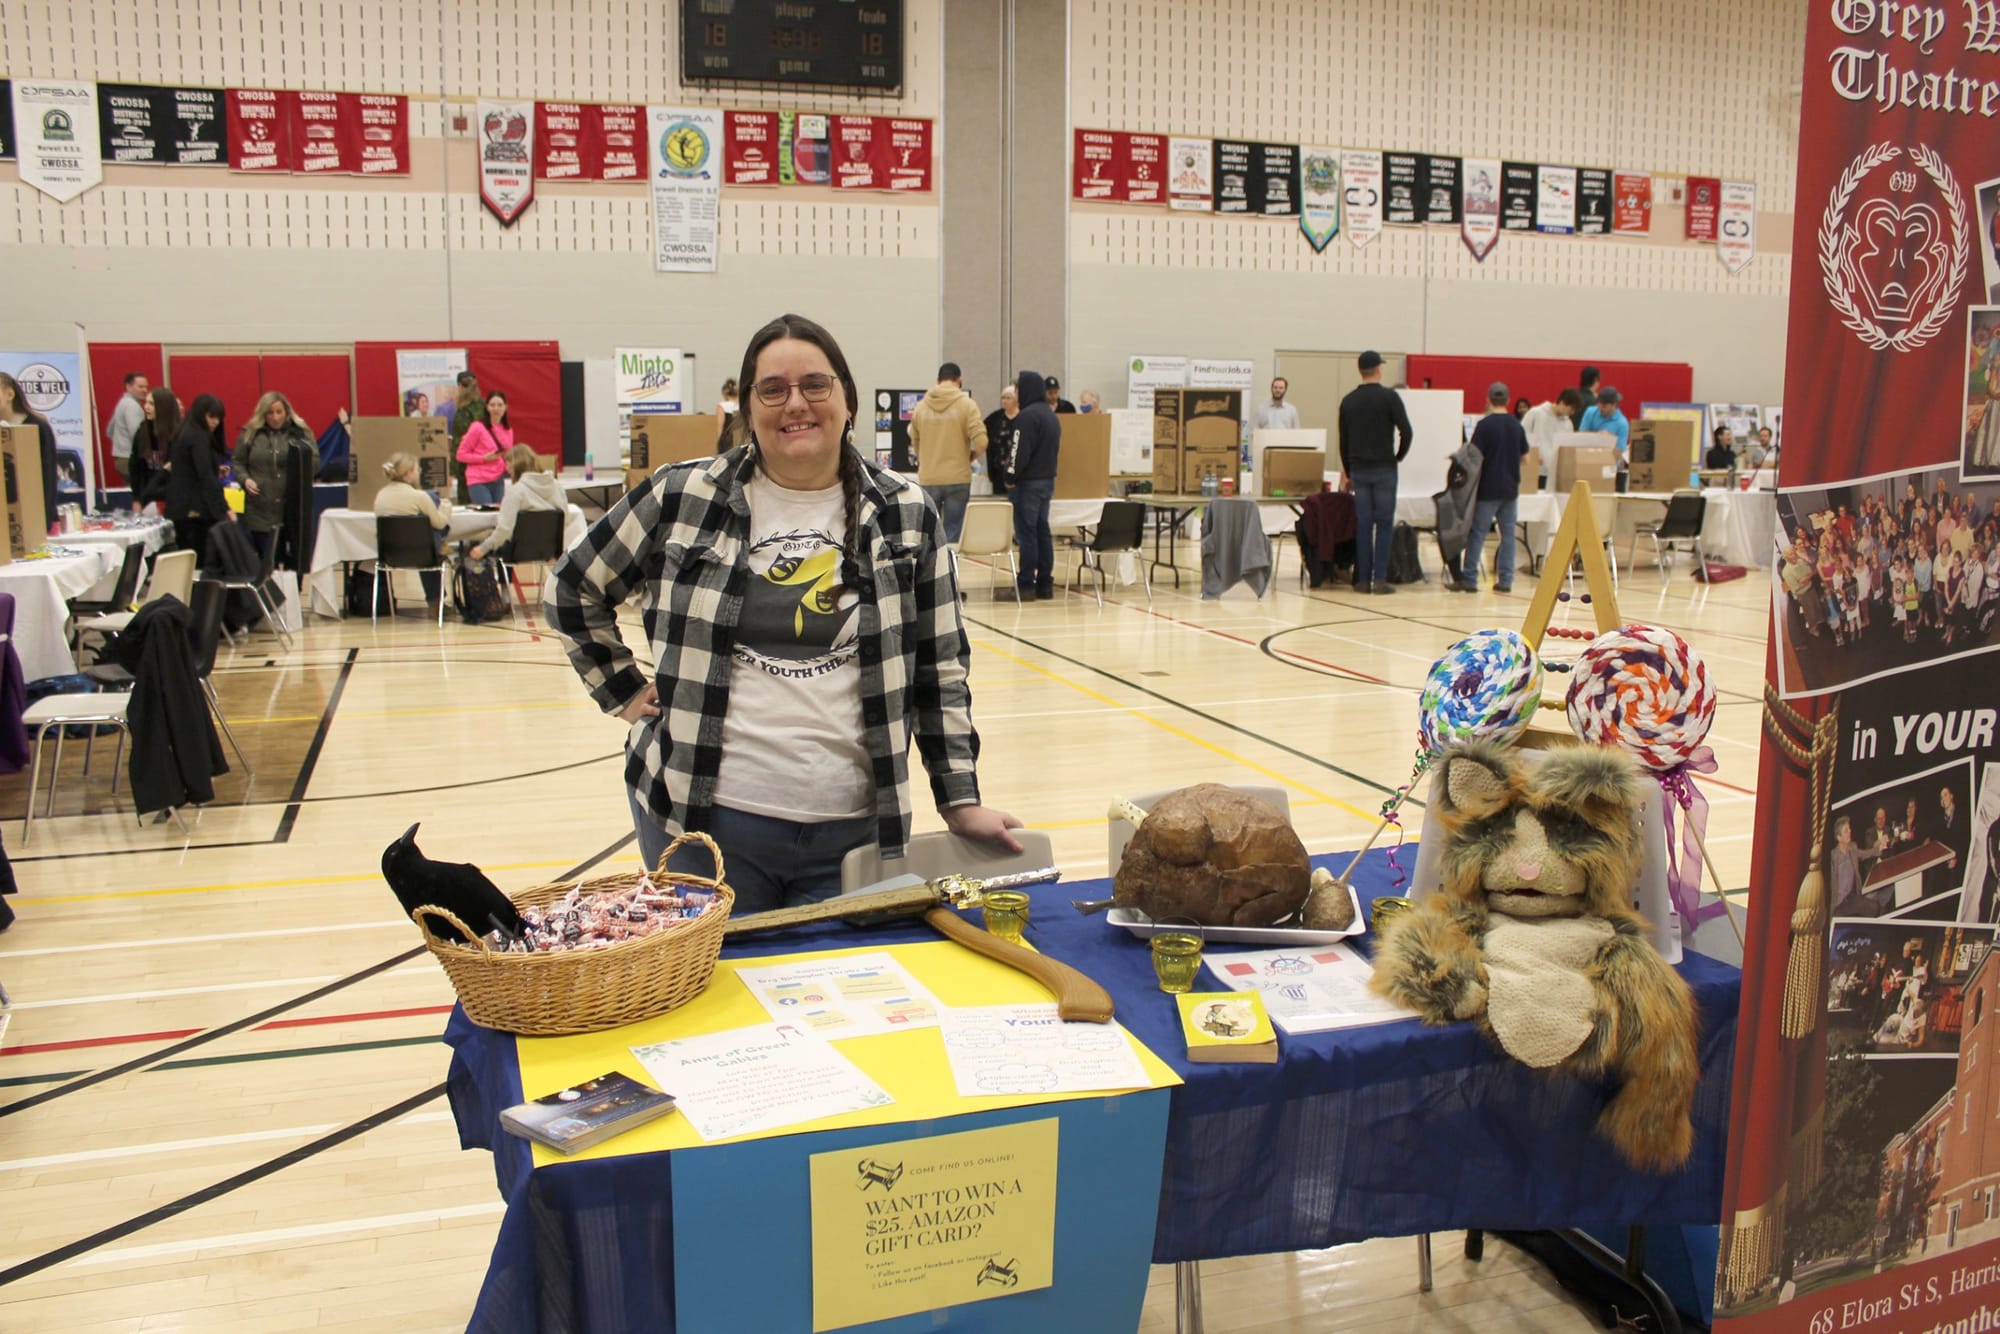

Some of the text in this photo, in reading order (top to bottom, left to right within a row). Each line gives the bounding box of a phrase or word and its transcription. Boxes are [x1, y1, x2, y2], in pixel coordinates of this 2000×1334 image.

[703, 55, 729, 68] won
[779, 59, 811, 75] game
[861, 65, 885, 77] won
[1828, 46, 2000, 118] Theatre
[111, 96, 151, 109] CWOSSA
[175, 91, 214, 102] CWOSSA
[237, 91, 276, 101] CWOSSA
[299, 92, 338, 101] CWOSSA
[360, 96, 397, 106] CWOSSA
[545, 103, 580, 113] CWOSSA
[601, 105, 636, 114] CWOSSA
[734, 114, 768, 124] CWOSSA
[115, 148, 153, 160] CHAMPIONS
[179, 149, 217, 162] CHAMPIONS
[41, 159, 80, 168] CWOSSA
[664, 243, 707, 253] CWOSSA
[659, 254, 712, 265] Champions
[622, 353, 674, 375] Minto
[18, 382, 69, 393] IDE WELL
[760, 661, 813, 678] YOUTH
[1852, 709, 1997, 761] in YOUR
[1005, 1019, 1056, 1027] Your
[680, 1054, 719, 1066] Anne
[745, 1042, 791, 1053] Green
[716, 1053, 769, 1068] Gables
[910, 1166, 935, 1175] COME
[939, 1162, 960, 1171] FIND
[977, 1154, 1015, 1166] ONLINE!
[866, 1178, 1023, 1216] WANT TO WIN A
[909, 1201, 996, 1229] AMAZON
[866, 1223, 982, 1256] GIFT CARD?
[1809, 1307, 1834, 1334] 68
[1840, 1296, 1892, 1330] Elora
[1899, 1283, 1920, 1310] St
[1925, 1276, 1942, 1304] S,
